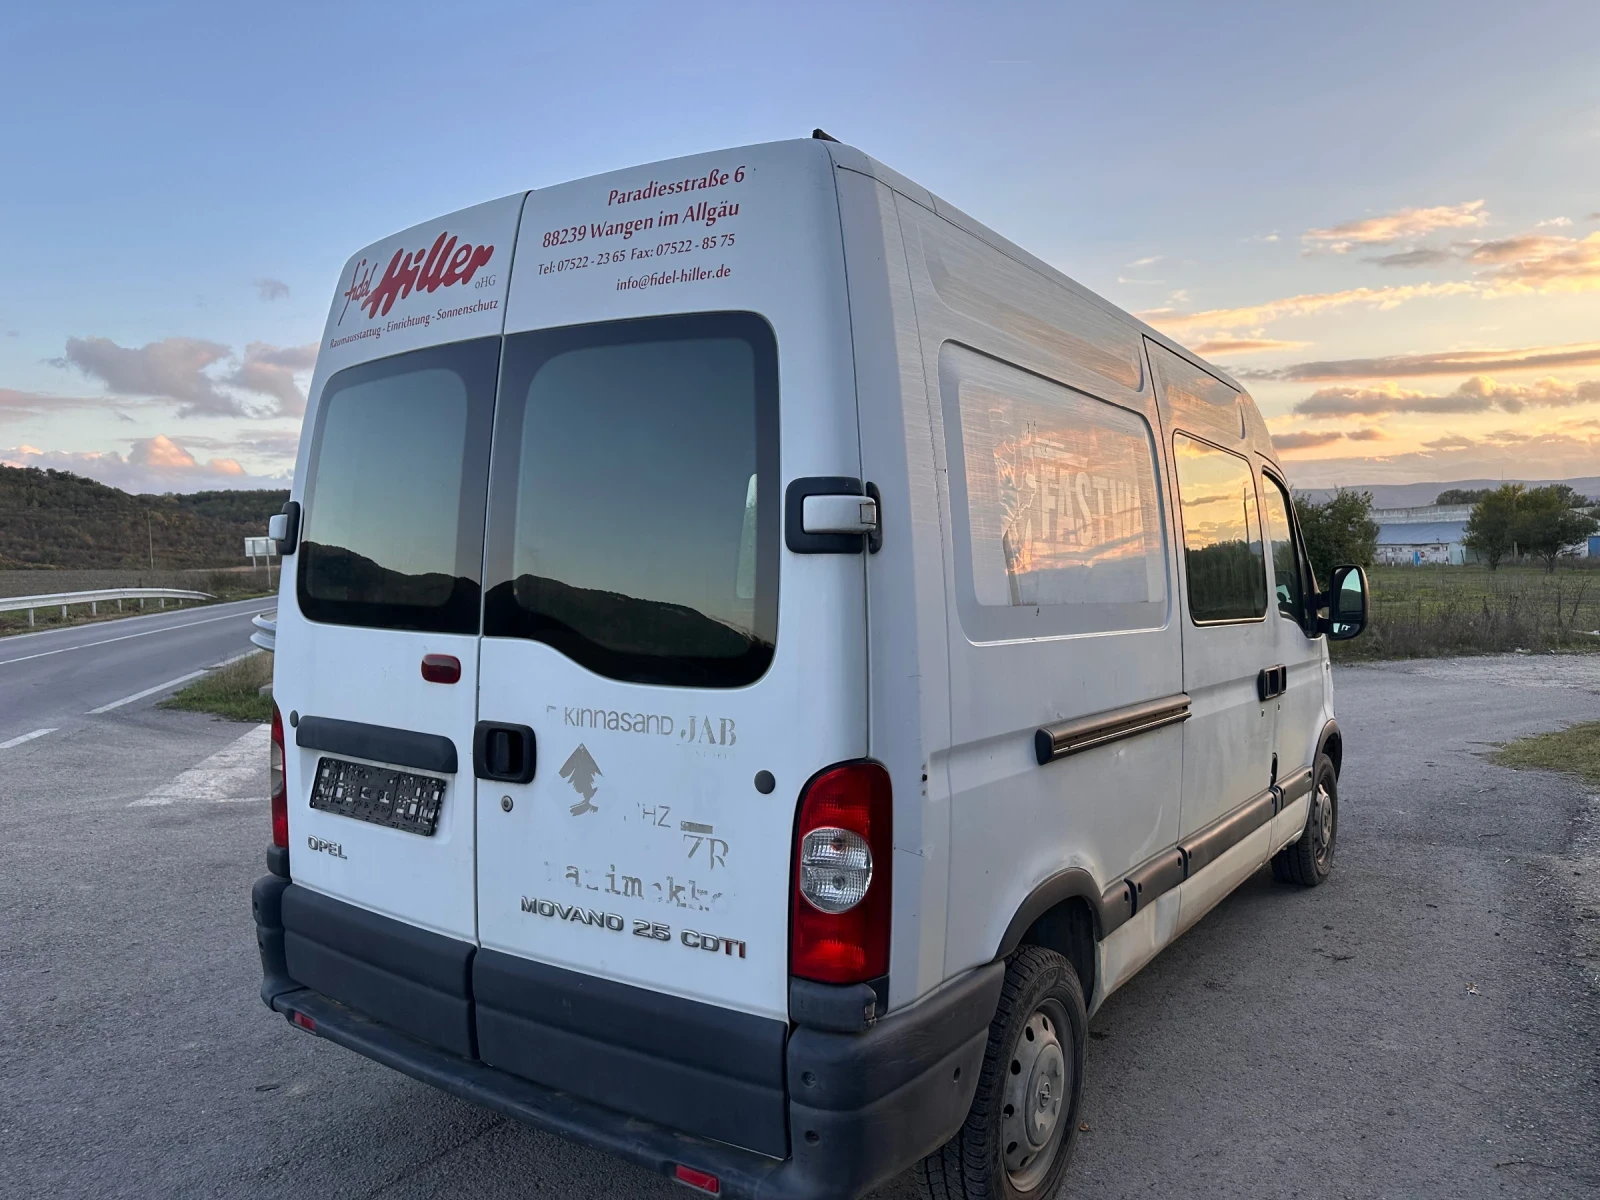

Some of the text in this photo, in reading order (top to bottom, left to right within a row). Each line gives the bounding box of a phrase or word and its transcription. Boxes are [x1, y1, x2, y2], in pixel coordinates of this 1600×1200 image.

[607, 165, 746, 206] Paradiesstraße 6
[542, 200, 740, 248] 88239 Wangen im Allgäu
[360, 231, 495, 319] Hiller
[474, 274, 496, 290] oHG
[538, 261, 556, 275] Tel:
[557, 256, 589, 272] 07522
[630, 246, 654, 260] Fax:
[656, 239, 692, 257] 07522
[616, 263, 731, 291] info@fidel-hiller.de
[386, 314, 430, 332] Einrichtung
[436, 299, 499, 320] Sonnenschutz
[679, 715, 737, 747] JAB
[307, 835, 348, 860] OPEL
[520, 895, 624, 932] MOVANO
[680, 928, 747, 959] CDTI
